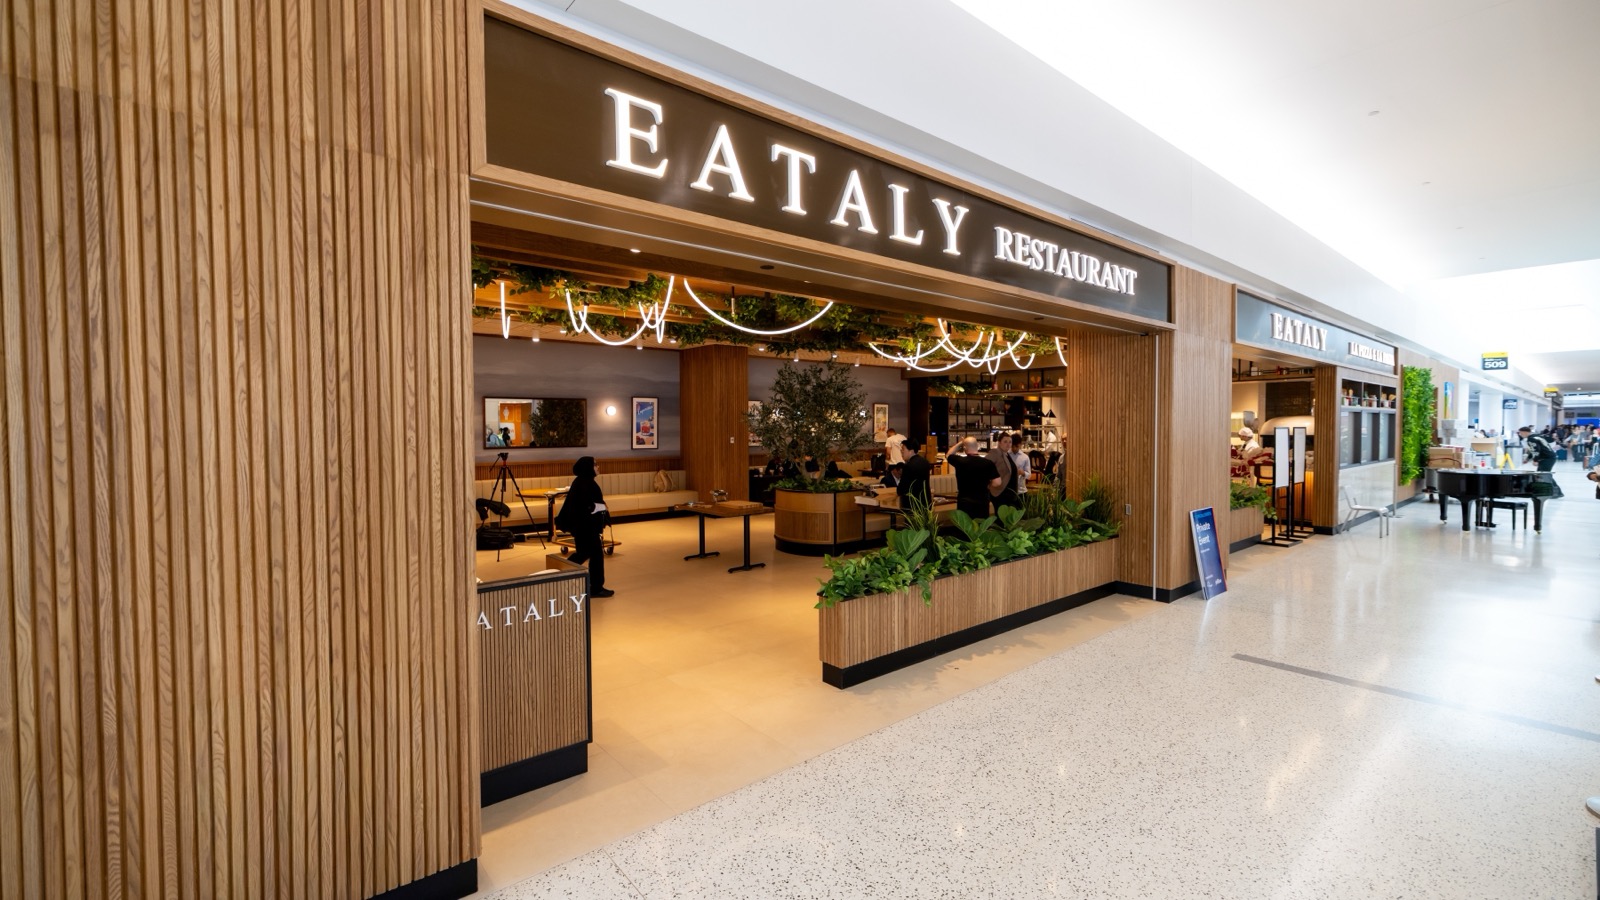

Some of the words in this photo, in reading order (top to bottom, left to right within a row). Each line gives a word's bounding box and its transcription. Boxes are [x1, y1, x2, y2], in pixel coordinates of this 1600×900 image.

[604, 87, 970, 256] EATALY
[994, 226, 1138, 295] RESTAURANT
[1270, 312, 1328, 351] EATALY
[1484, 360, 1506, 369] 509
[1196, 522, 1210, 532] Private
[1198, 535, 1210, 545] Event
